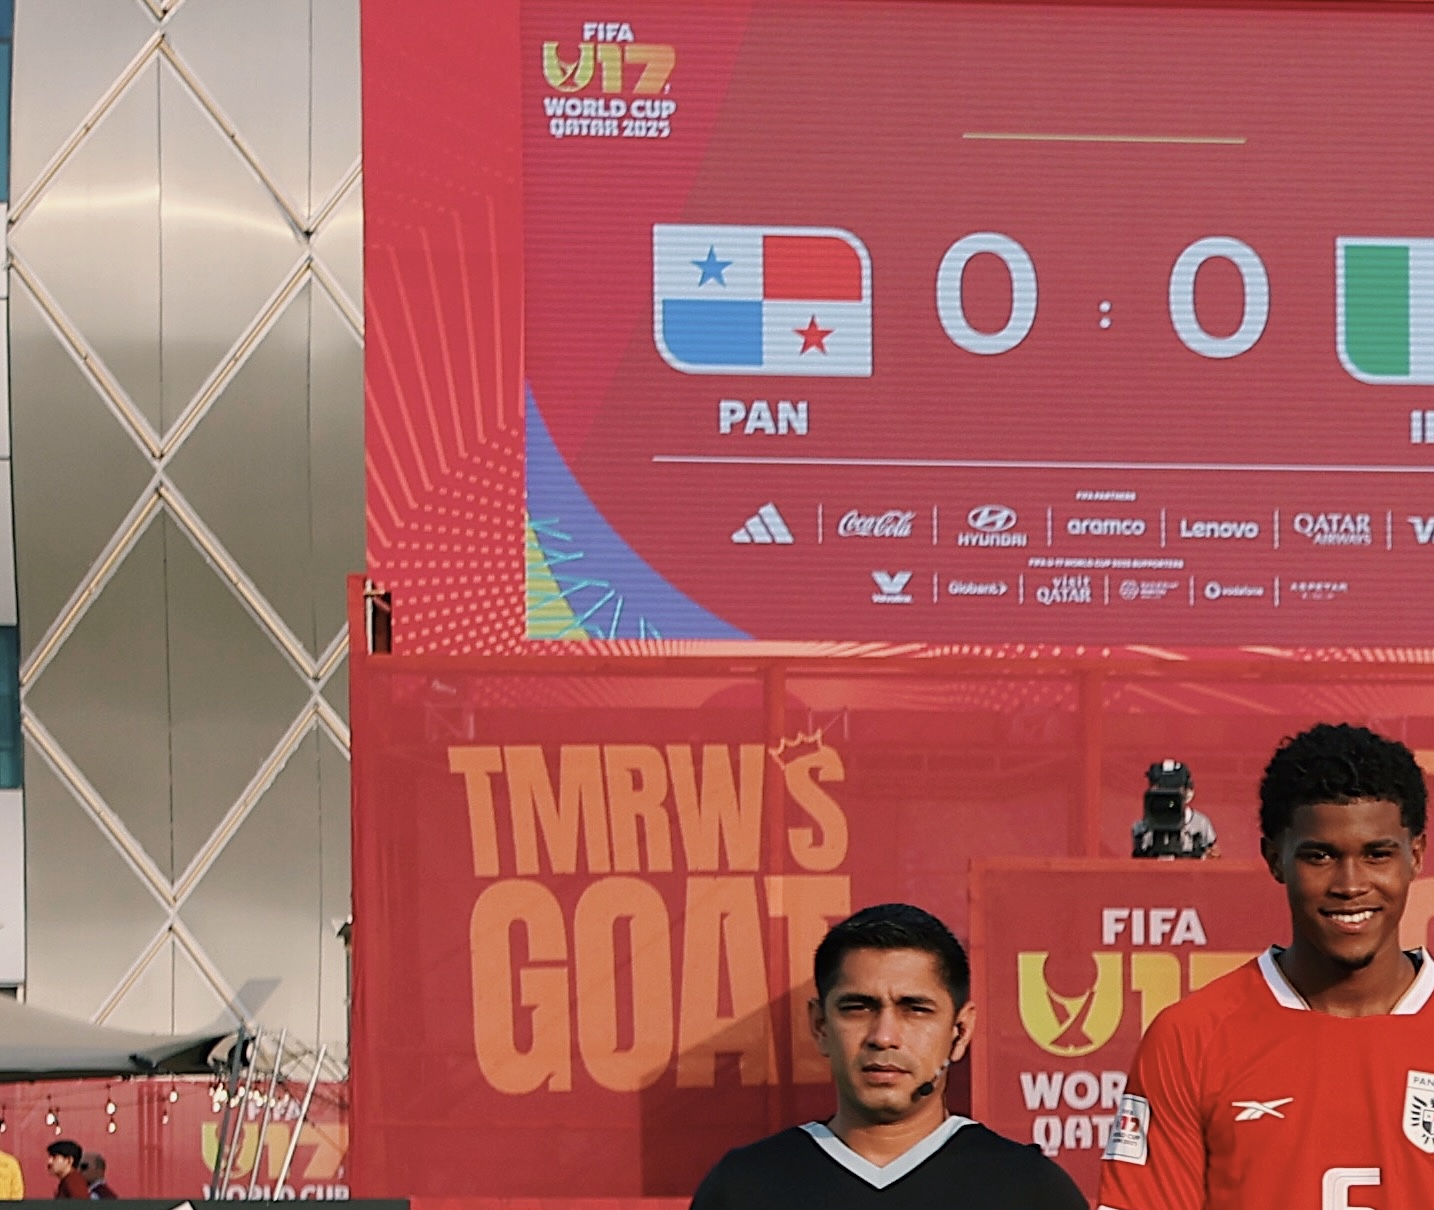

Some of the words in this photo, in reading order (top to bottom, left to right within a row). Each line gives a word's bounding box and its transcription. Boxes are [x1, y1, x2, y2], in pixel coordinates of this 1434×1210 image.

[583, 22, 634, 42] FIFA
[543, 41, 676, 93] U17
[543, 97, 627, 118] WORLD
[631, 98, 677, 119] CUP
[549, 117, 619, 138] QATAR
[622, 118, 671, 138] 2025
[936, 231, 1038, 355] 0
[1168, 236, 1271, 359] 0
[719, 400, 808, 435] PAN
[1067, 518, 1146, 536] aramco
[1180, 518, 1259, 538] Lenovo
[1293, 513, 1372, 536] QATAR
[958, 532, 1027, 548] HYUNDAI
[1037, 586, 1091, 605] QATAR
[1102, 907, 1208, 946] FIFA
[1020, 1070, 1128, 1111] WOR
